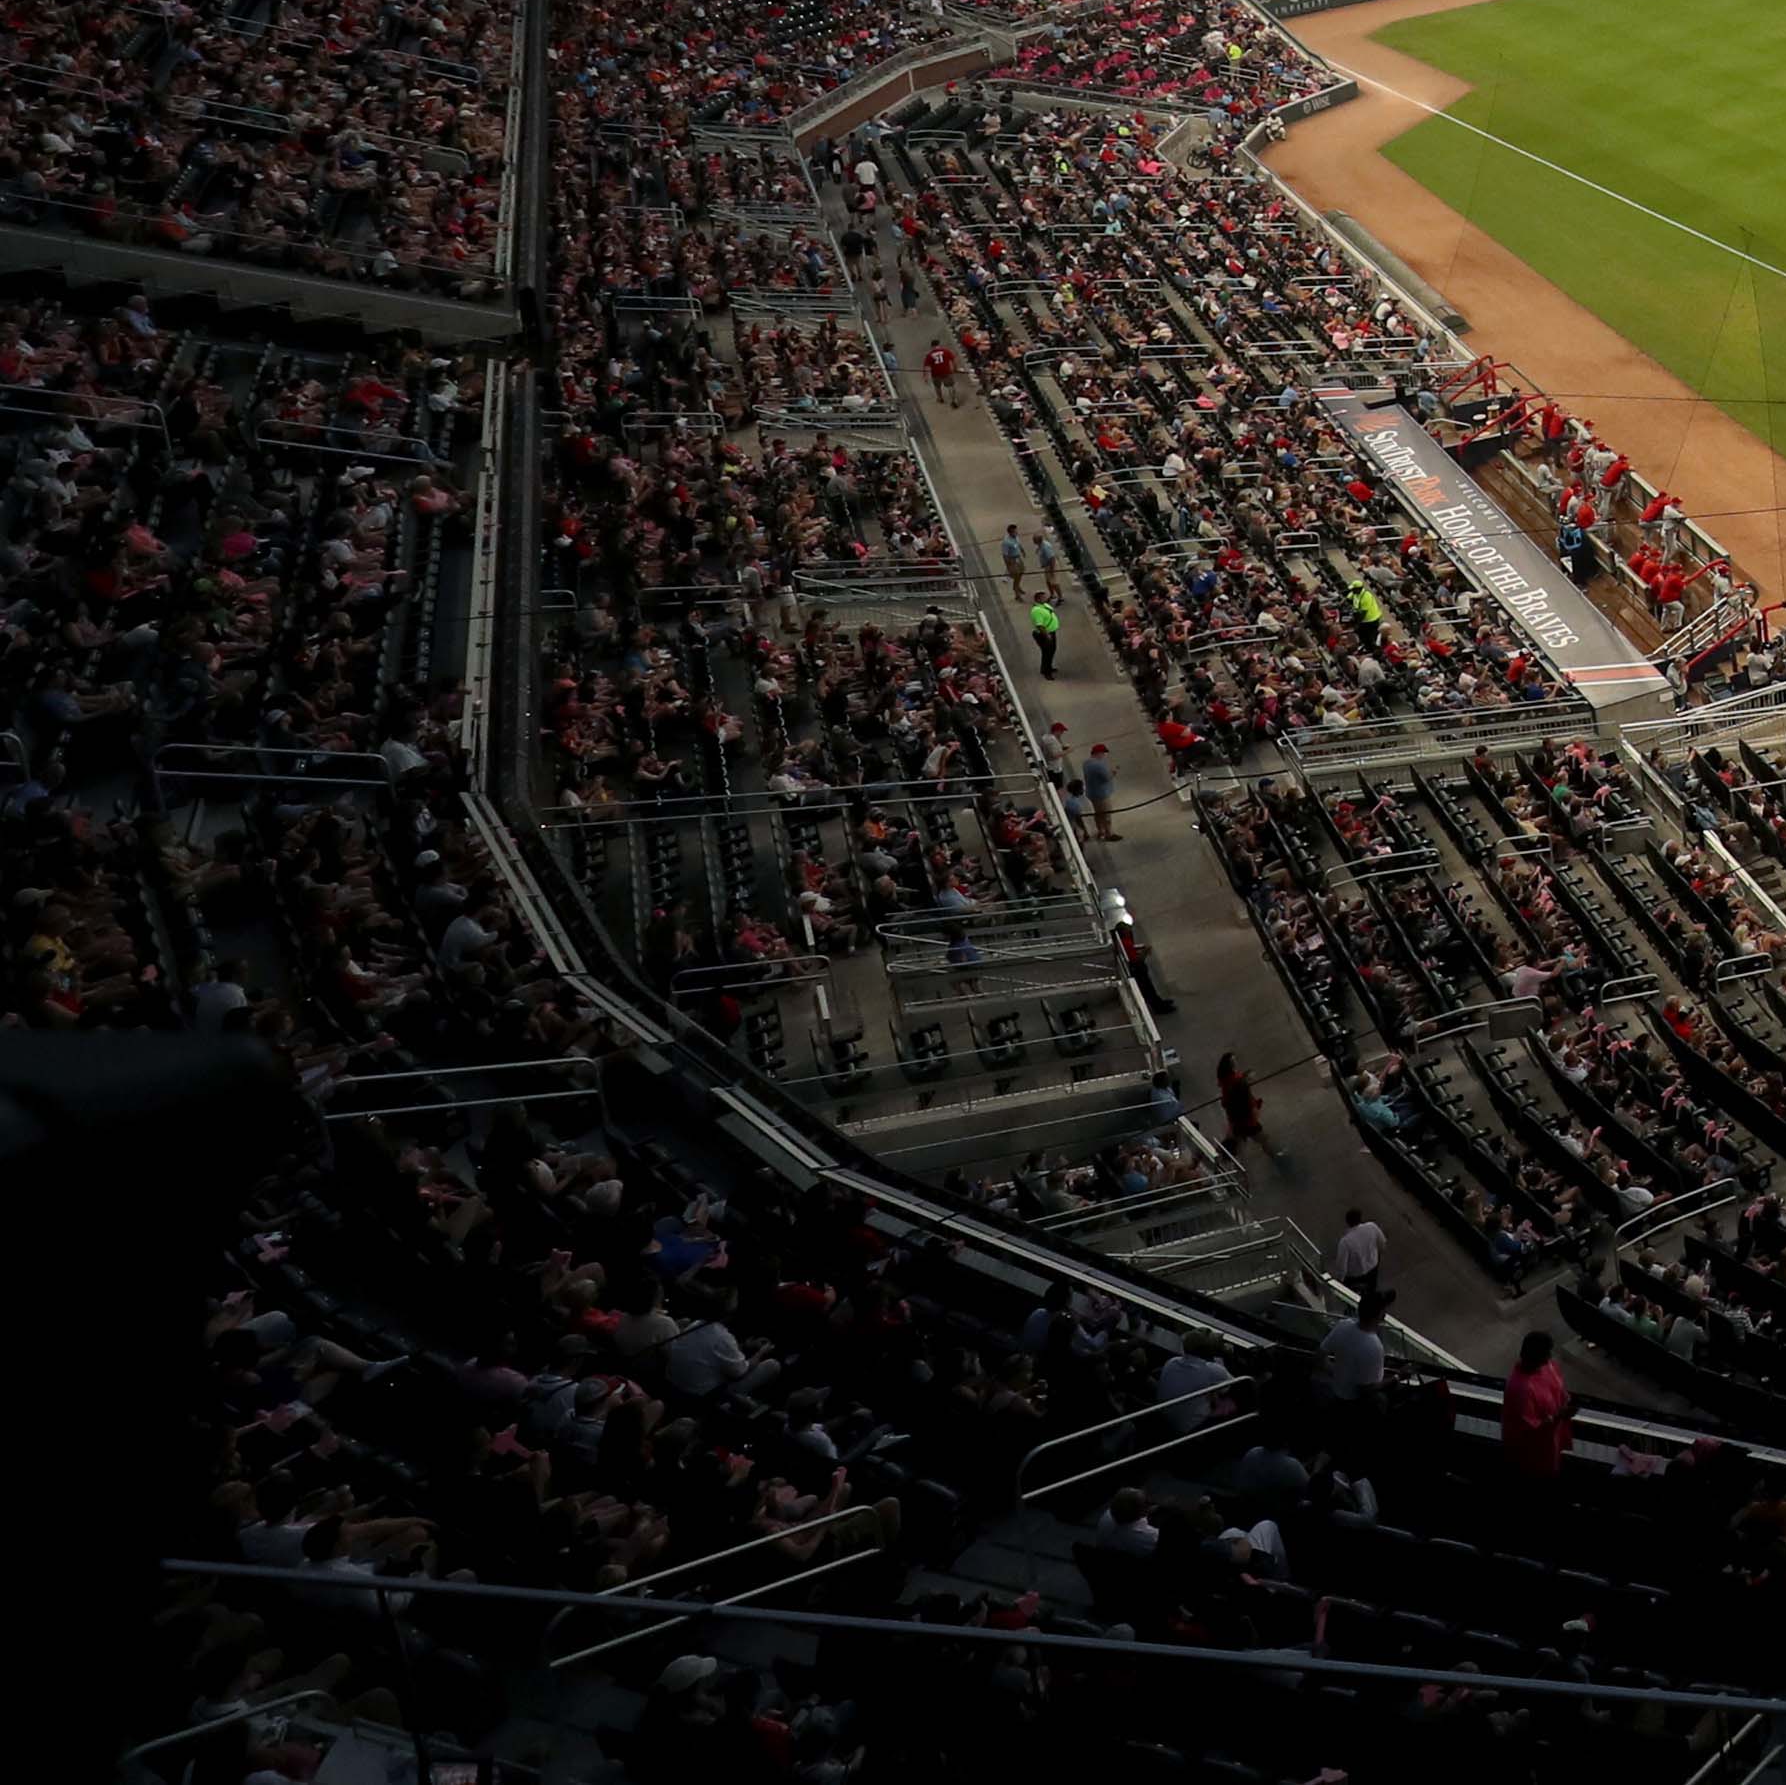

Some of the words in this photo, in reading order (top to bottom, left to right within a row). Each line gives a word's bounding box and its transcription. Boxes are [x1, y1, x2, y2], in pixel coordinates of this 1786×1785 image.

[1433, 503, 1475, 552] HOME
[1466, 541, 1498, 571] OF
[1485, 563, 1522, 595] THE
[1508, 587, 1579, 650] BRAVES
